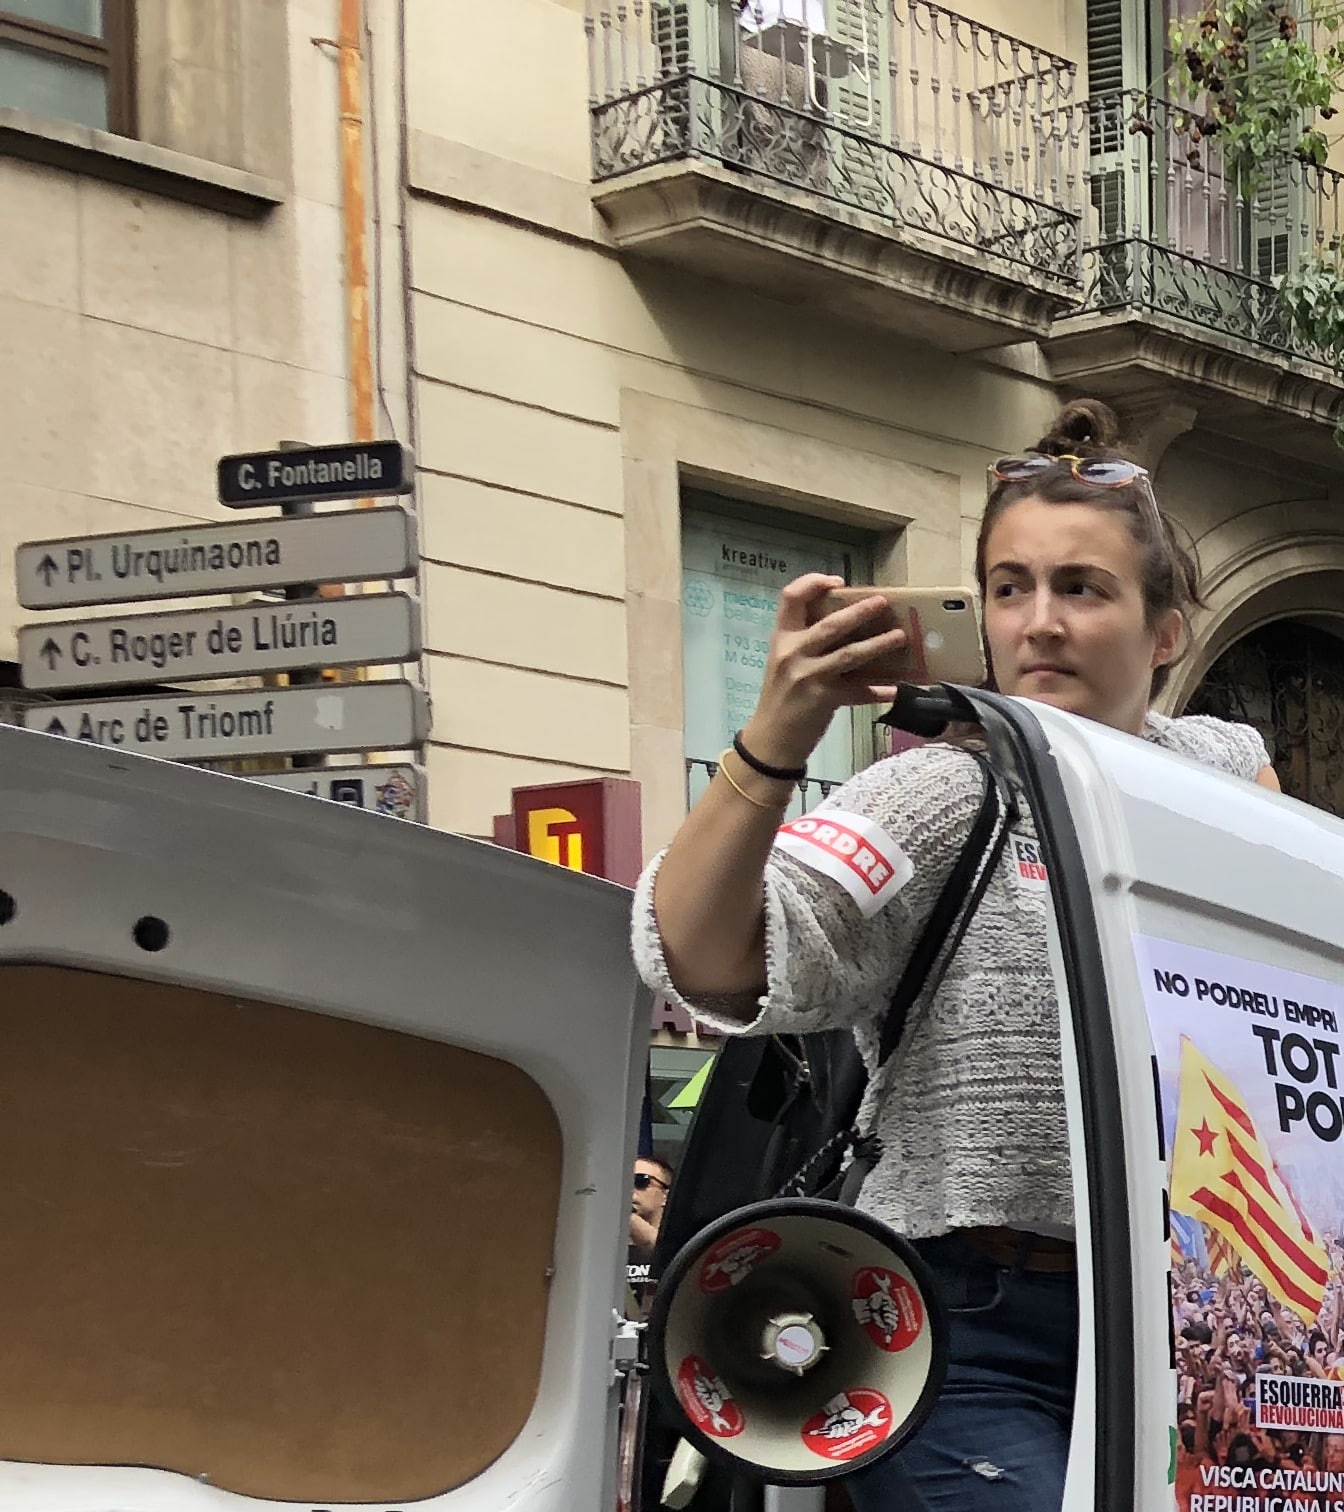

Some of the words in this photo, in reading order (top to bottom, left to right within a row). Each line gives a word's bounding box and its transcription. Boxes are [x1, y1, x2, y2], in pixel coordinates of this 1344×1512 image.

[237, 464, 262, 491] C.
[267, 452, 383, 488] Fontanella
[66, 548, 102, 584] Pl.
[111, 538, 282, 583] Urquinaona
[722, 544, 787, 573] kreative
[71, 631, 101, 667] C.
[109, 626, 197, 669] Roger
[206, 619, 243, 655] de
[253, 611, 339, 652] Llúria
[76, 711, 125, 745] Arc
[134, 708, 169, 743] de
[179, 699, 275, 740] Triomf
[790, 818, 891, 888] ORDRE
[1153, 968, 1190, 998] NO
[1194, 978, 1279, 1018] PODREU
[1251, 1023, 1341, 1090] TOT
[1259, 1378, 1344, 1410] ESQUERRA
[1200, 1465, 1257, 1489] VISCA
